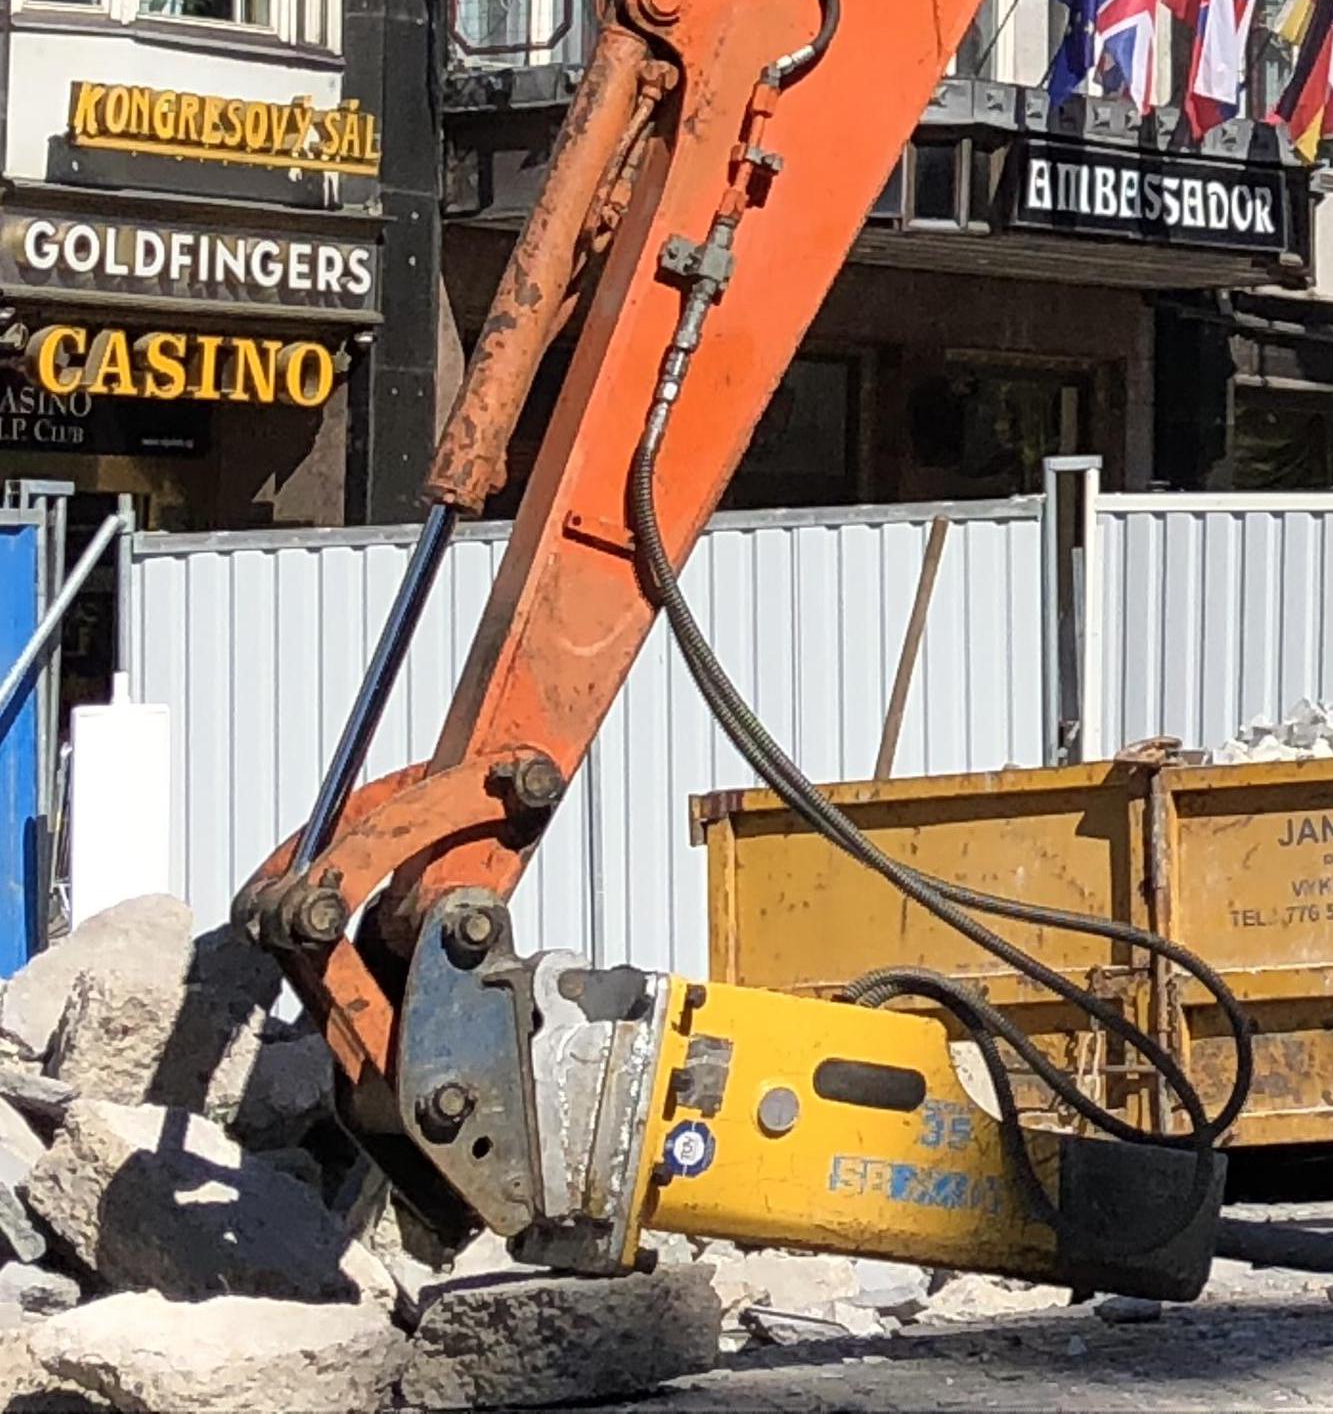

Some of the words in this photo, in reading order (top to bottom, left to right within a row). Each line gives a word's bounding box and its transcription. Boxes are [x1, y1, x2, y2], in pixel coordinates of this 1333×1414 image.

[74, 81, 312, 157] KONGRESOVÝ
[321, 98, 380, 160] SÁL
[1027, 158, 1274, 234] AMBASSADOR
[25, 221, 372, 294] GOLDFINGERS
[39, 324, 334, 406] CASINO
[1286, 905, 1319, 923] 776
